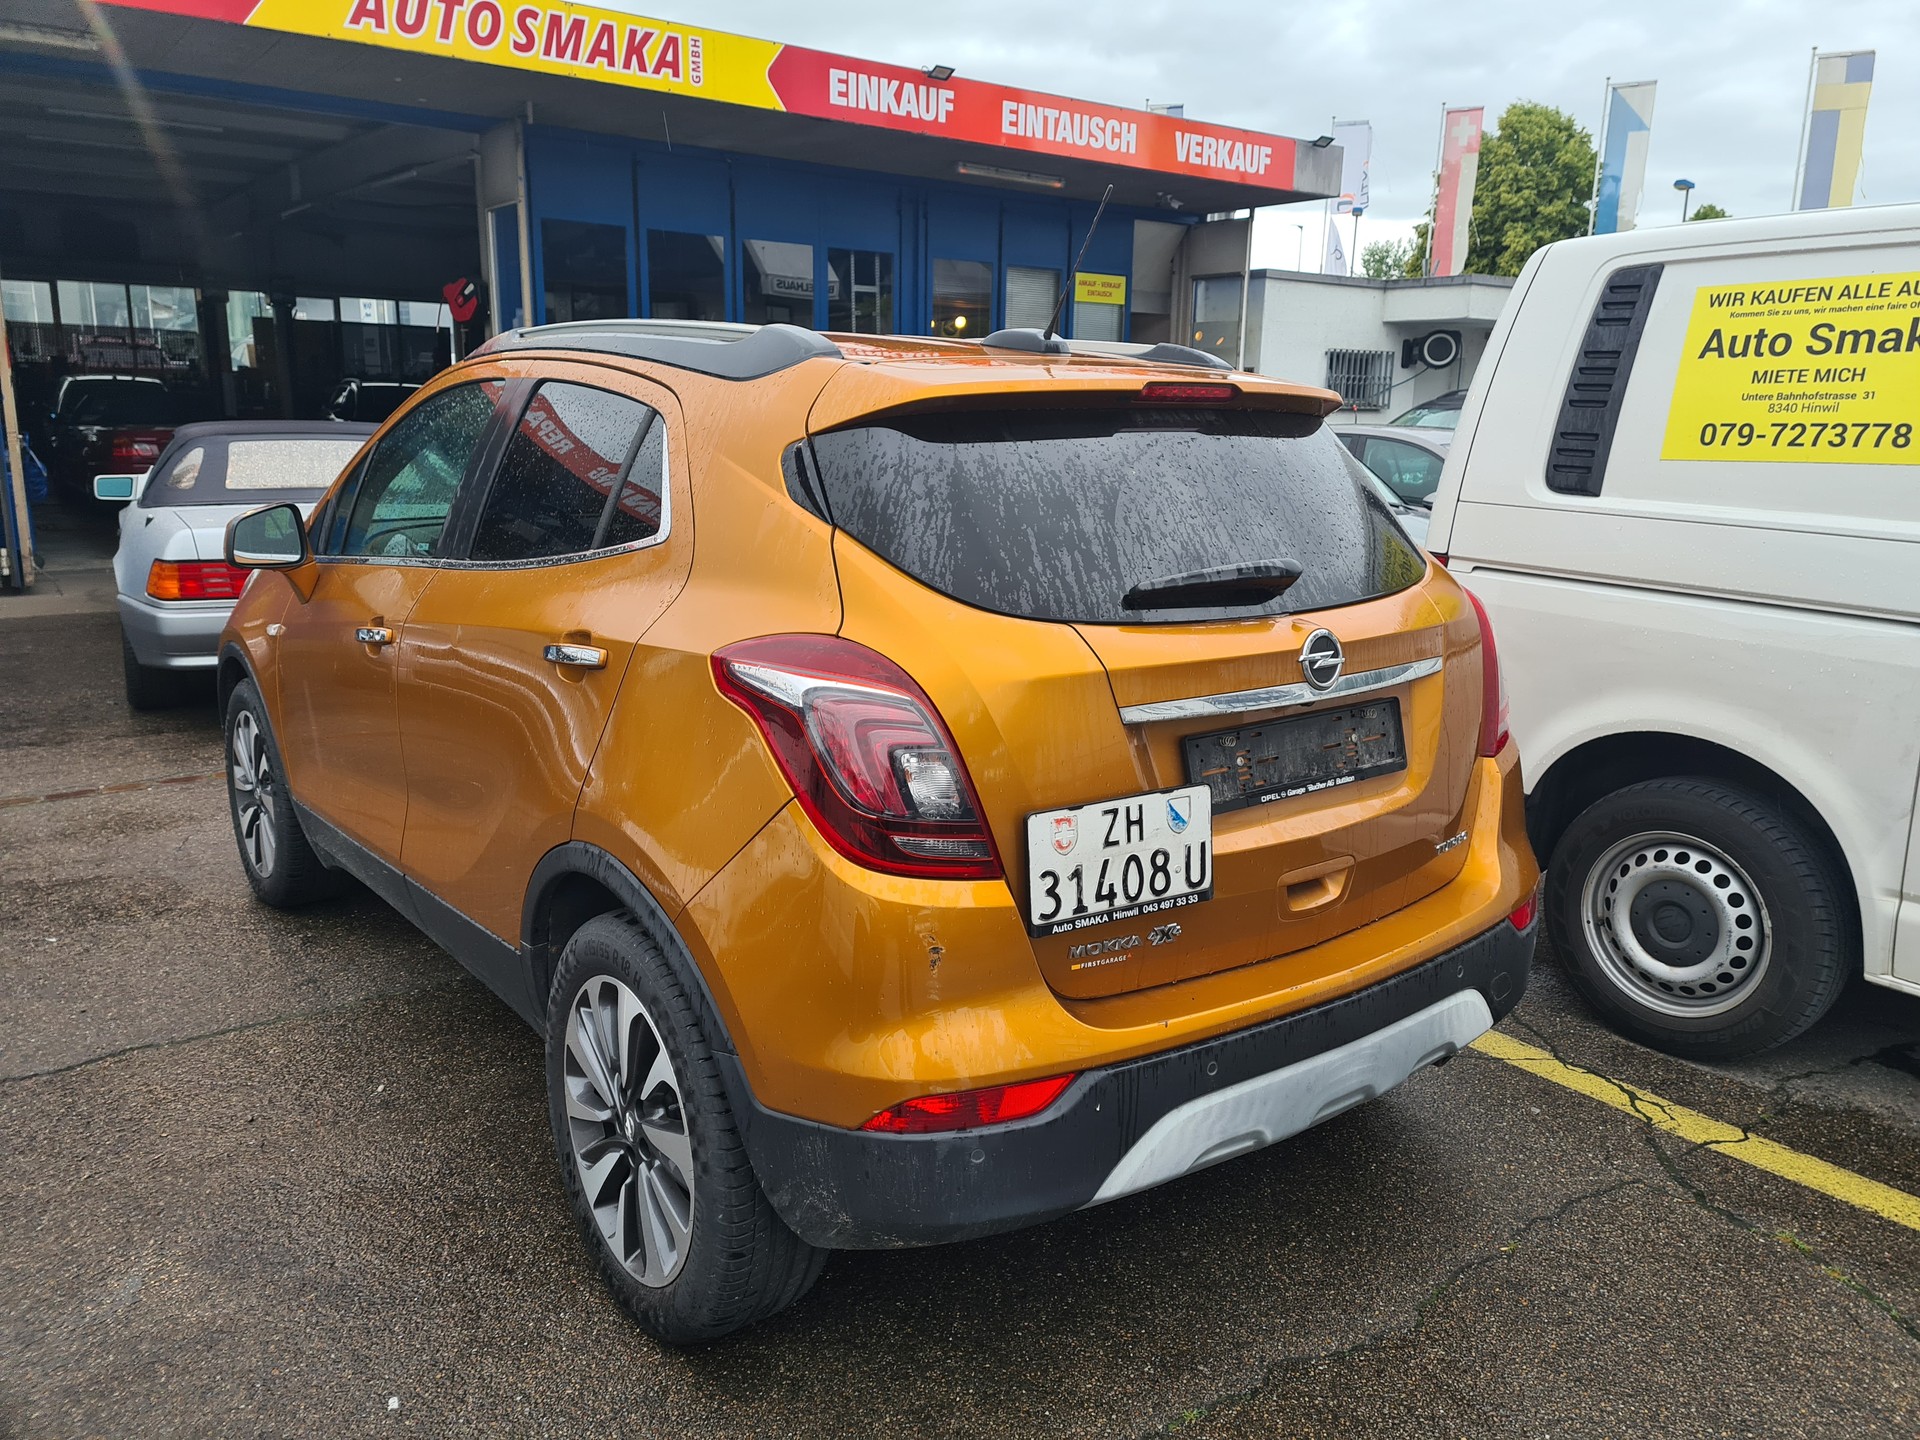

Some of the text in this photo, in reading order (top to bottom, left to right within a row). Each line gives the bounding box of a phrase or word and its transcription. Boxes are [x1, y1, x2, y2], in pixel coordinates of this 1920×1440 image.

[345, 0, 702, 85] AUTO SMAKA GMBH
[829, 68, 1272, 175] EINKAUF EINTAUSCH VERKAUF
[1710, 292, 1745, 308] WIR
[1750, 286, 1833, 306] KAUFEN
[1837, 282, 1893, 300] ALLE
[1730, 311, 1765, 319] Kommen
[1767, 309, 1780, 317] Sie
[1794, 308, 1811, 316] uns,
[1814, 306, 1826, 314] wir
[1828, 305, 1863, 313] machen
[1865, 303, 1885, 311] eine
[1887, 301, 1908, 310] faire
[1698, 316, 1920, 359] Auto Smak
[1751, 367, 1866, 385] MIETE MICH
[1741, 391, 1875, 402] Untere Bahnhofstrasse 31
[1767, 402, 1840, 413] 8340 Hinwil
[1700, 422, 1914, 449] 079-7273778
[1261, 793, 1281, 803] OPEL
[1287, 787, 1306, 797] Garage
[1327, 779, 1335, 788] AG
[1102, 803, 1144, 849] ZH
[1052, 894, 1199, 935] Auto SMAKA Hinwil 043 497 33 33
[1067, 935, 1142, 960] MOKKA
